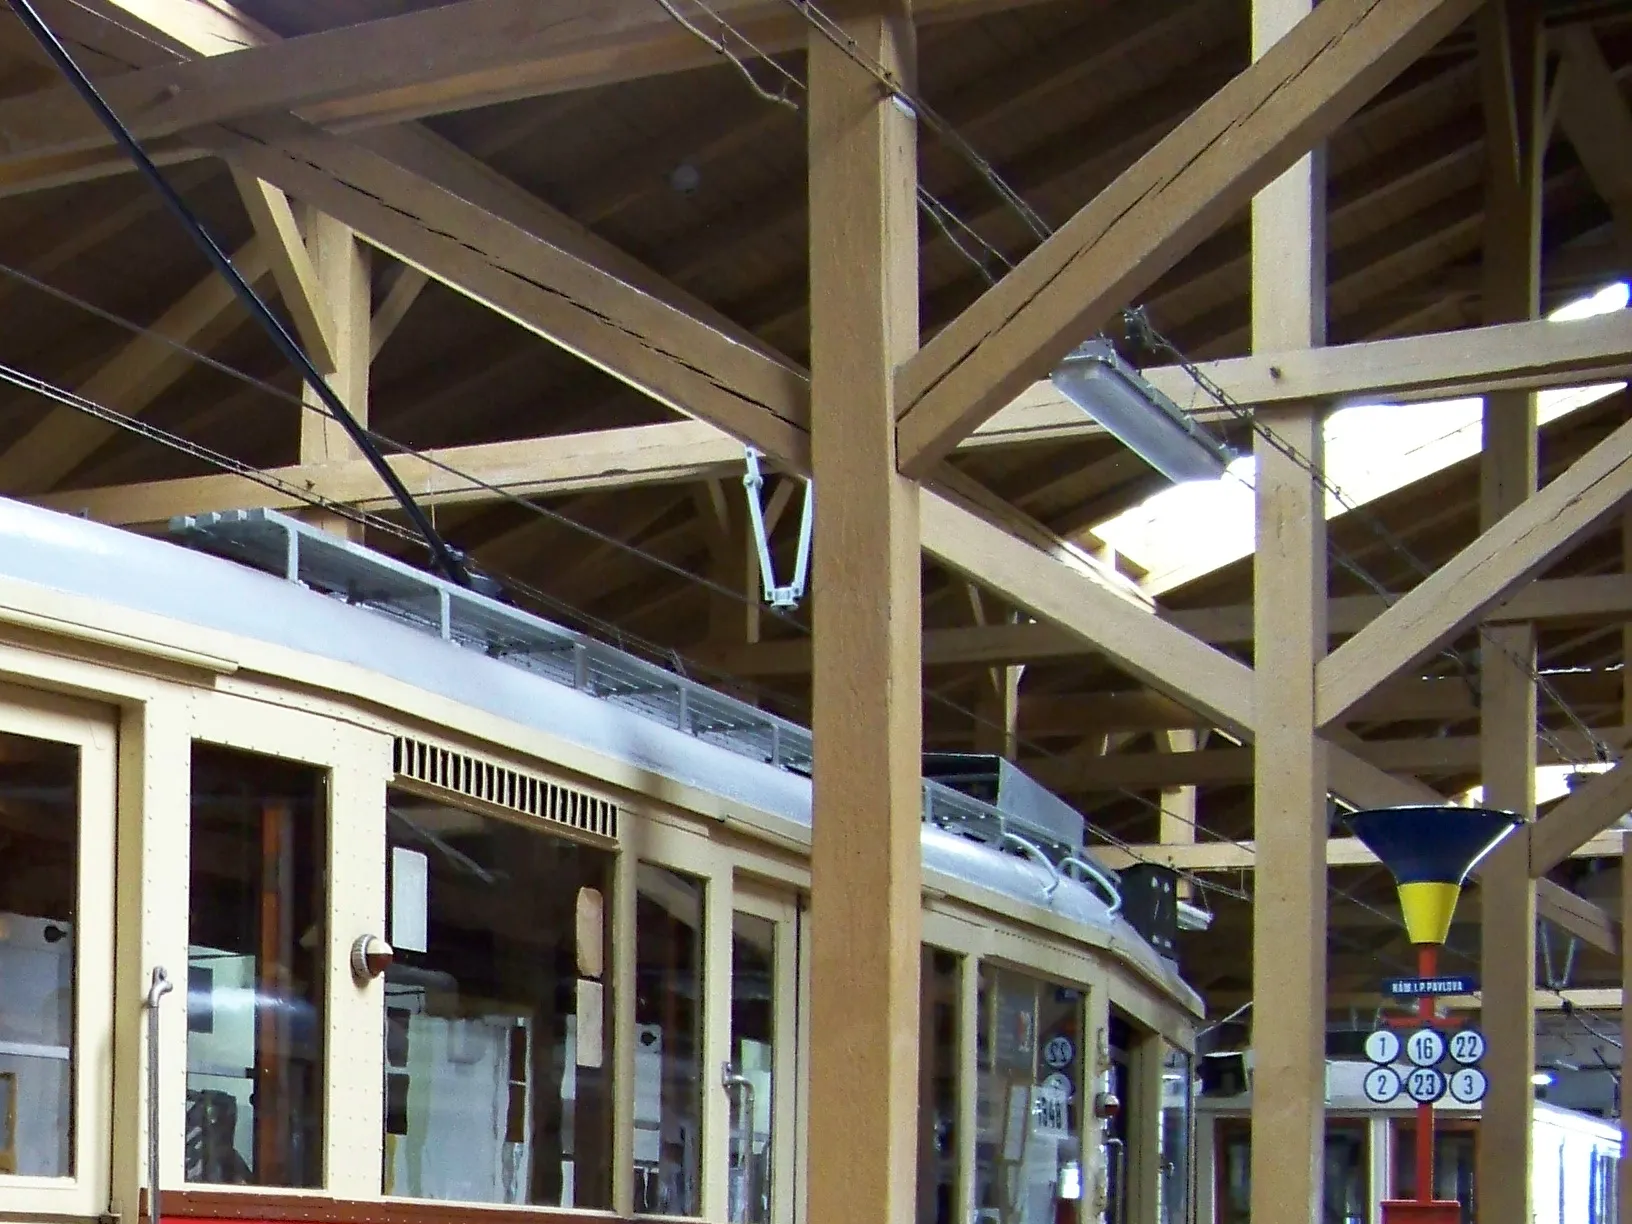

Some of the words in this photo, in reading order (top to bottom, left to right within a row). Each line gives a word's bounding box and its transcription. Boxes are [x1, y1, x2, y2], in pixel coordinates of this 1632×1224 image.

[1379, 1037, 1386, 1056] 1
[1416, 1037, 1433, 1060] 16
[1456, 1036, 1477, 1058] 22
[1378, 1075, 1387, 1095] 2
[1414, 1074, 1435, 1096] 23
[1464, 1075, 1473, 1095] 3
